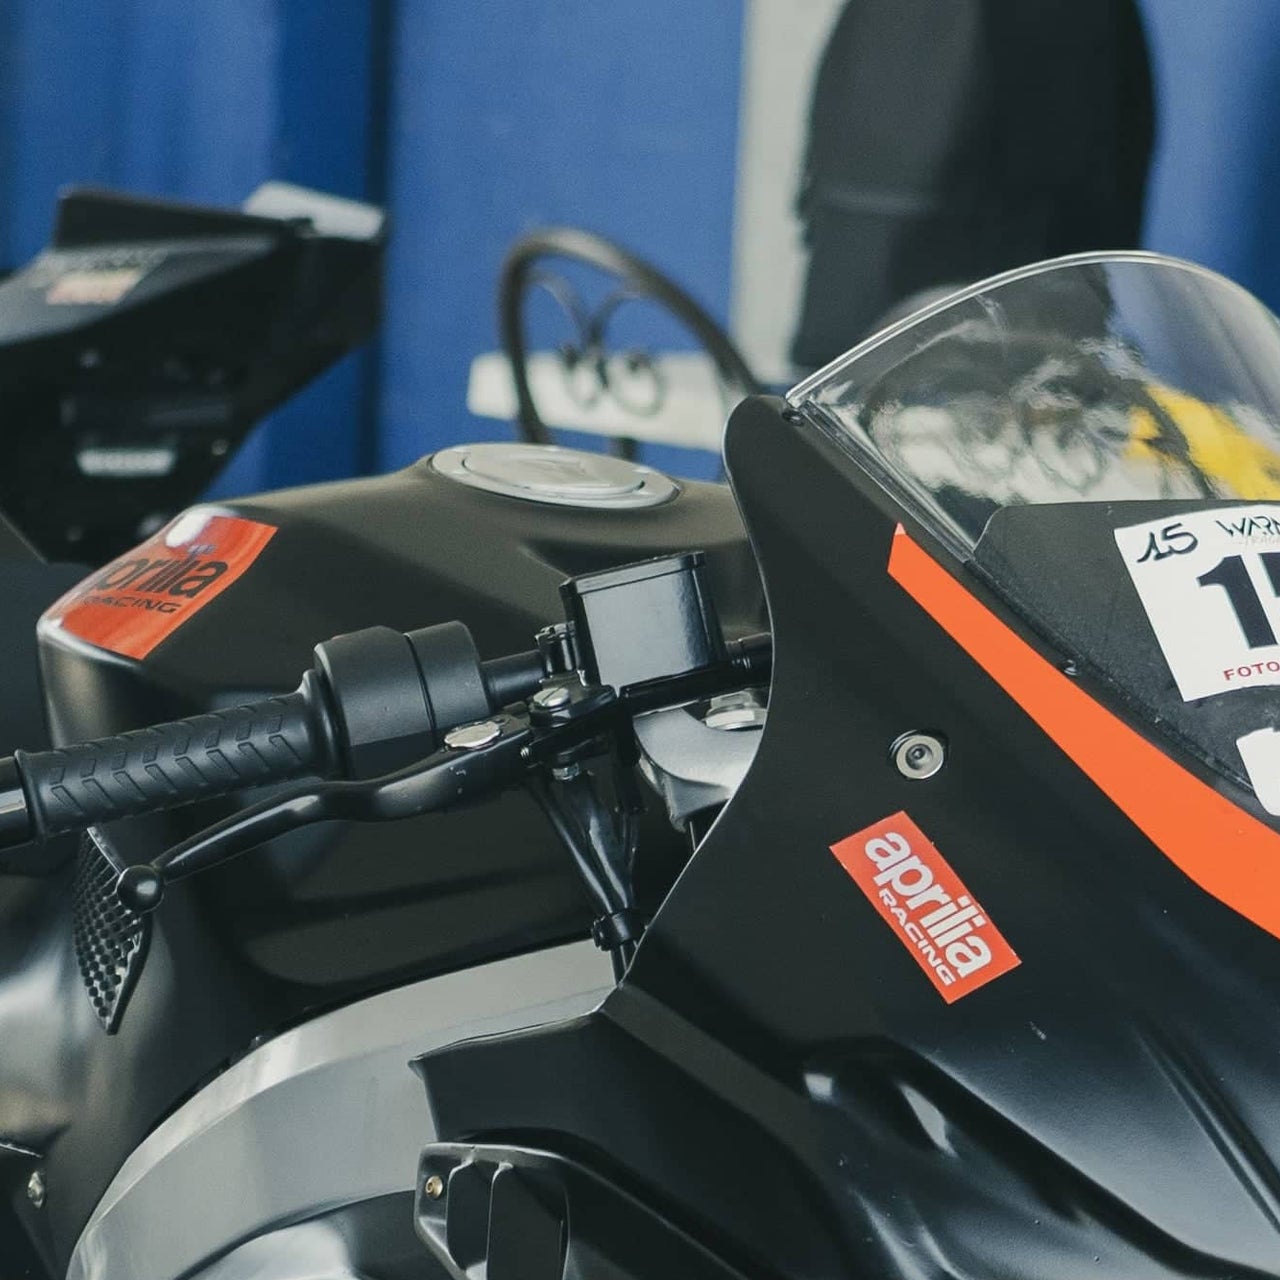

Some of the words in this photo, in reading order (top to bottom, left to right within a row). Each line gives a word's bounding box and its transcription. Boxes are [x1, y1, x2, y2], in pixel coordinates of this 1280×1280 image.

[92, 545, 228, 598] prilia
[865, 832, 992, 979] aprilia
[878, 888, 957, 986] RACING
